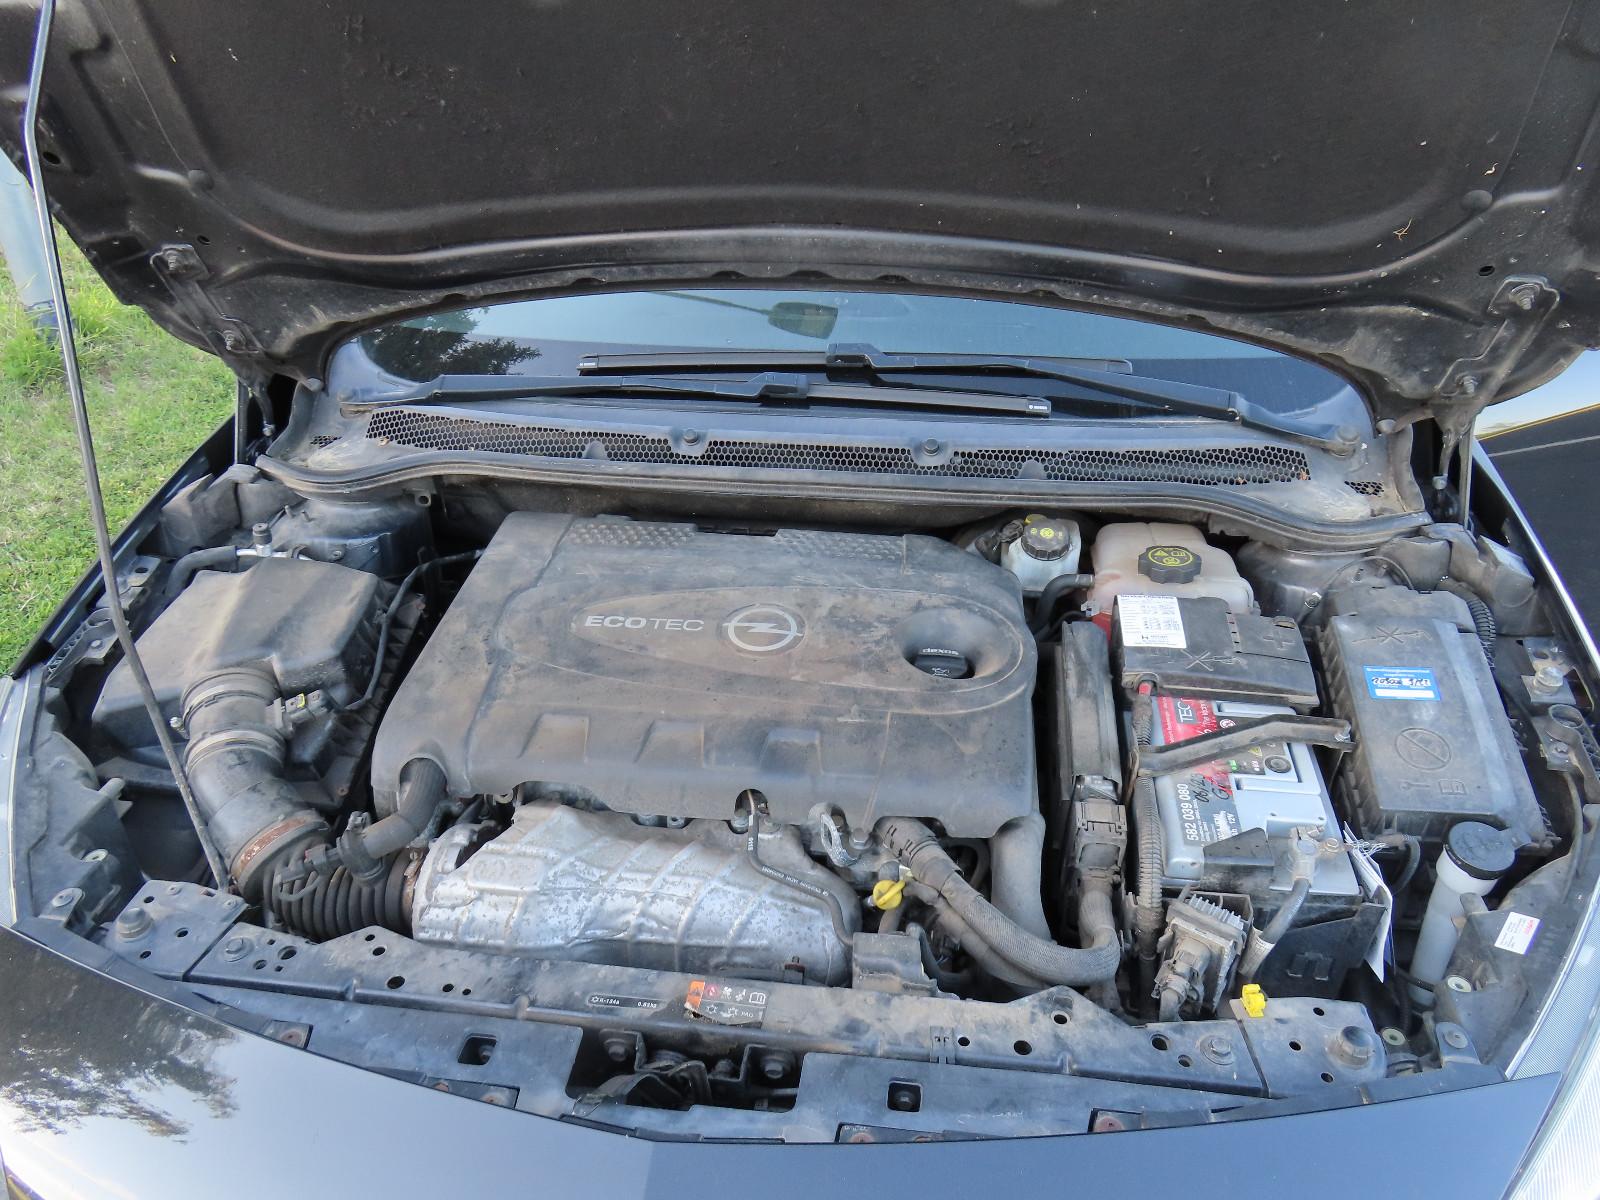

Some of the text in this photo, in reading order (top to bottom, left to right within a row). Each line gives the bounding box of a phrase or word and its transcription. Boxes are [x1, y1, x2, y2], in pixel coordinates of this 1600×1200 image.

[584, 615, 705, 631] ECOTEC
[922, 647, 959, 656] dexos
[1176, 783, 1191, 801] 080
[1180, 802, 1195, 820] 039
[1226, 812, 1236, 824] 12V
[1185, 822, 1199, 841] 582
